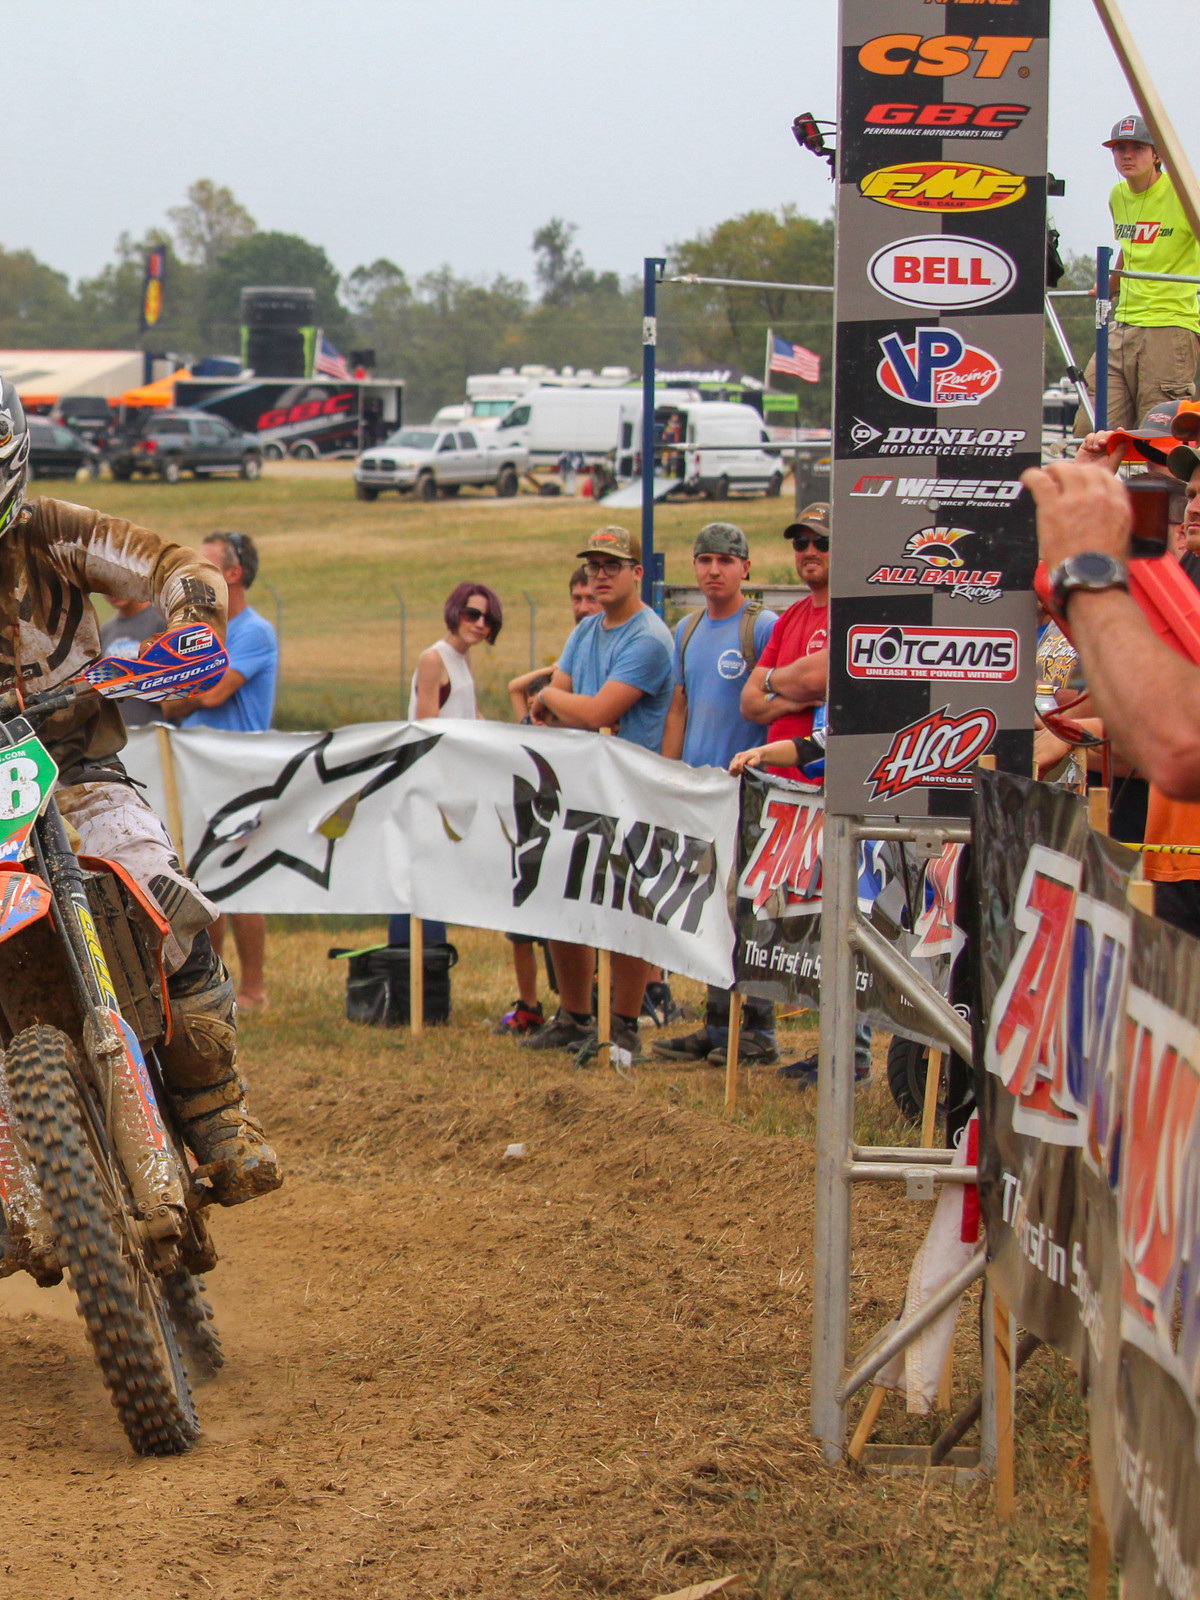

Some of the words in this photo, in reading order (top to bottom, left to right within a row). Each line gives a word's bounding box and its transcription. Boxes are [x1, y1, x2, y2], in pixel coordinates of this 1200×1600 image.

[858, 33, 1035, 79] CST
[863, 102, 1032, 130] GBC
[863, 127, 921, 136] PERFORMANCE
[921, 129, 979, 138] MOTORSPORTS
[979, 130, 1003, 139] TIRES
[861, 168, 1027, 200] FMF
[893, 256, 991, 286] BELL
[879, 327, 965, 403] VP
[936, 369, 1003, 391] Racing
[937, 392, 980, 401] FUELS
[257, 393, 354, 430] GBC
[878, 444, 966, 456] MOTORCYCLE
[974, 446, 1014, 457] TIRES
[883, 427, 1026, 446] DUNLOP
[901, 498, 964, 507] Perfoance
[966, 500, 1011, 508] Products
[869, 568, 917, 583] ALL
[919, 570, 1002, 586] BALLS
[951, 584, 1003, 604] Racing
[853, 629, 1013, 667] HOTCAMS
[866, 668, 907, 676] UNLEASH
[911, 669, 927, 677] THE
[930, 670, 964, 678] POWER
[967, 671, 1003, 679] WITHIN
[885, 715, 990, 783] HBD
[921, 774, 945, 783] MOTO
[563, 808, 717, 935] THOR
[745, 940, 768, 968] The
[770, 945, 800, 975] First
[800, 952, 814, 978] in
[1002, 1172, 1024, 1229] Th
[1047, 1228, 1068, 1288] in
